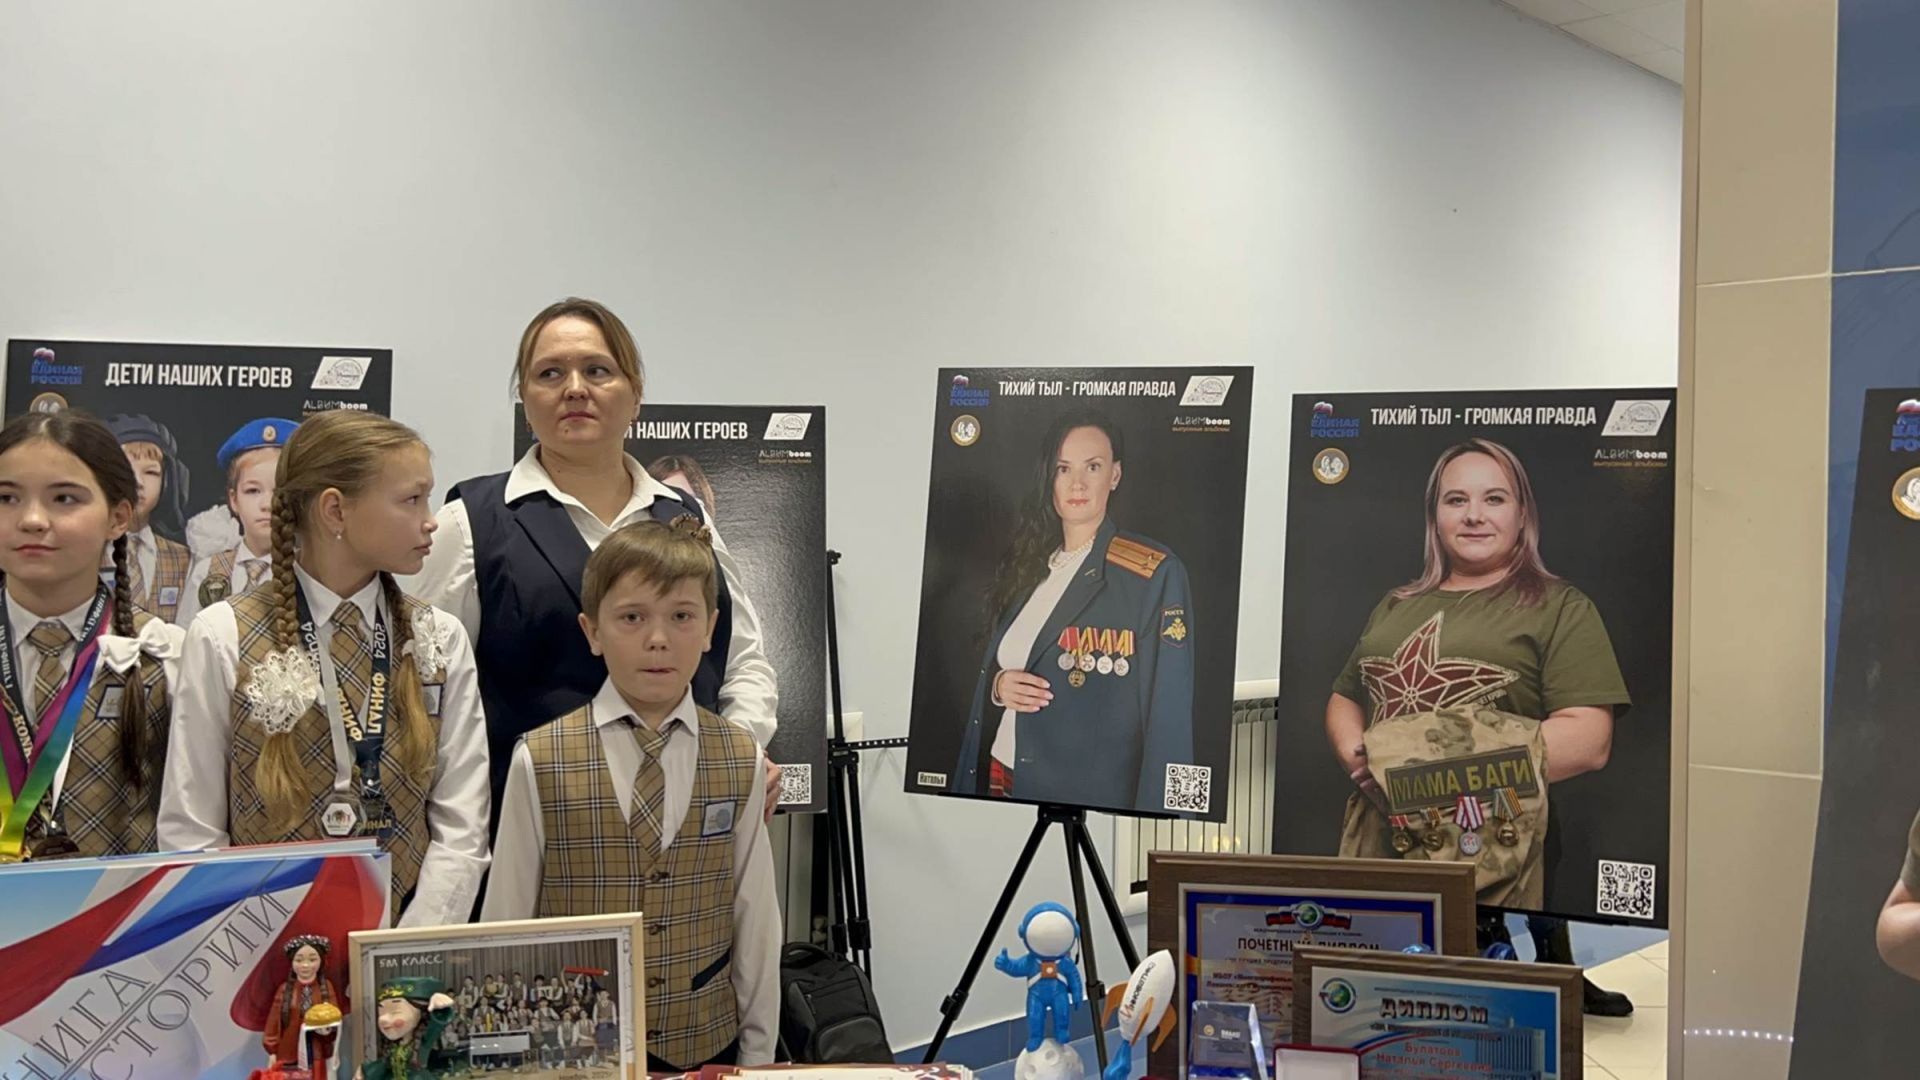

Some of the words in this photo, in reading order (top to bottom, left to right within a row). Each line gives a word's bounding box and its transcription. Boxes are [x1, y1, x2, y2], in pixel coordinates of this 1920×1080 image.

[105, 363, 153, 386] ДЕТИ
[158, 364, 223, 386] НАШИХ
[227, 366, 292, 388] ГЕРОЕВ
[999, 378, 1035, 396] ТИХИЙ
[1038, 381, 1063, 396] ТЫЛ
[1072, 381, 1126, 396] ГРОМКАЯ
[1128, 381, 1176, 397] ПРАВДА
[637, 422, 691, 439] НАШИХ
[695, 422, 748, 439] ГЕРОЕВ
[1370, 405, 1417, 425] ТИХИЙ
[1420, 408, 1451, 425] ТЫЛ
[1464, 408, 1532, 425] ГРОМКАЯ
[1536, 407, 1597, 426] ПРАВДА
[374, 623, 386, 660] 2024
[337, 687, 362, 742] ФИН
[367, 672, 386, 734] ФИНАЛ
[1392, 769, 1462, 801] МАМА
[1466, 758, 1532, 791] БАГИ
[1238, 937, 1311, 952] ПОЧЕТН
[67, 891, 292, 1080] СТОРИИ
[0, 968, 151, 1080] НИГА
[1381, 998, 1488, 1024] ДИПЛОМ
